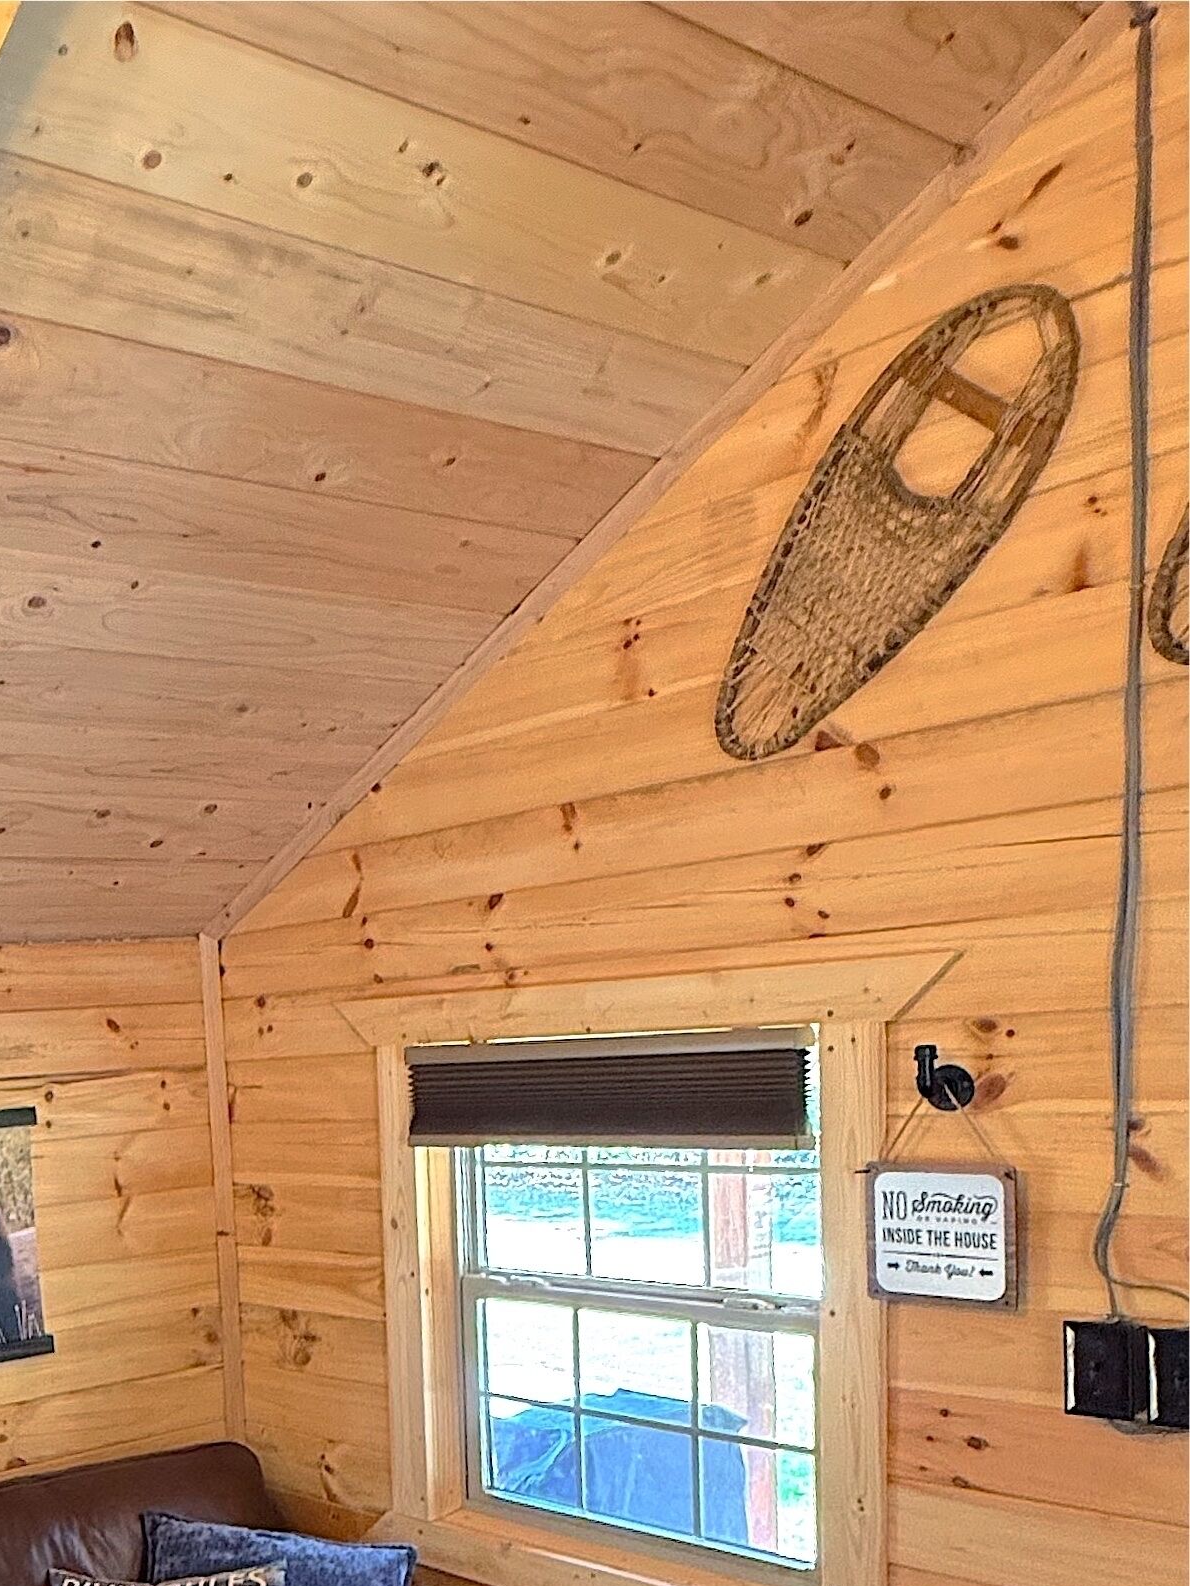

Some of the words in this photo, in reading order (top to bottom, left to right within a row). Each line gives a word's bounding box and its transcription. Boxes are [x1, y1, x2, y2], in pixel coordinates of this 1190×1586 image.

[882, 1191, 907, 1220] NO
[912, 1192, 998, 1222] Smoking
[882, 1227, 923, 1245] INSIDE
[927, 1230, 950, 1247] THE
[954, 1232, 998, 1250] HOUSE
[905, 1260, 942, 1274] Thank
[944, 1264, 975, 1280] You!
